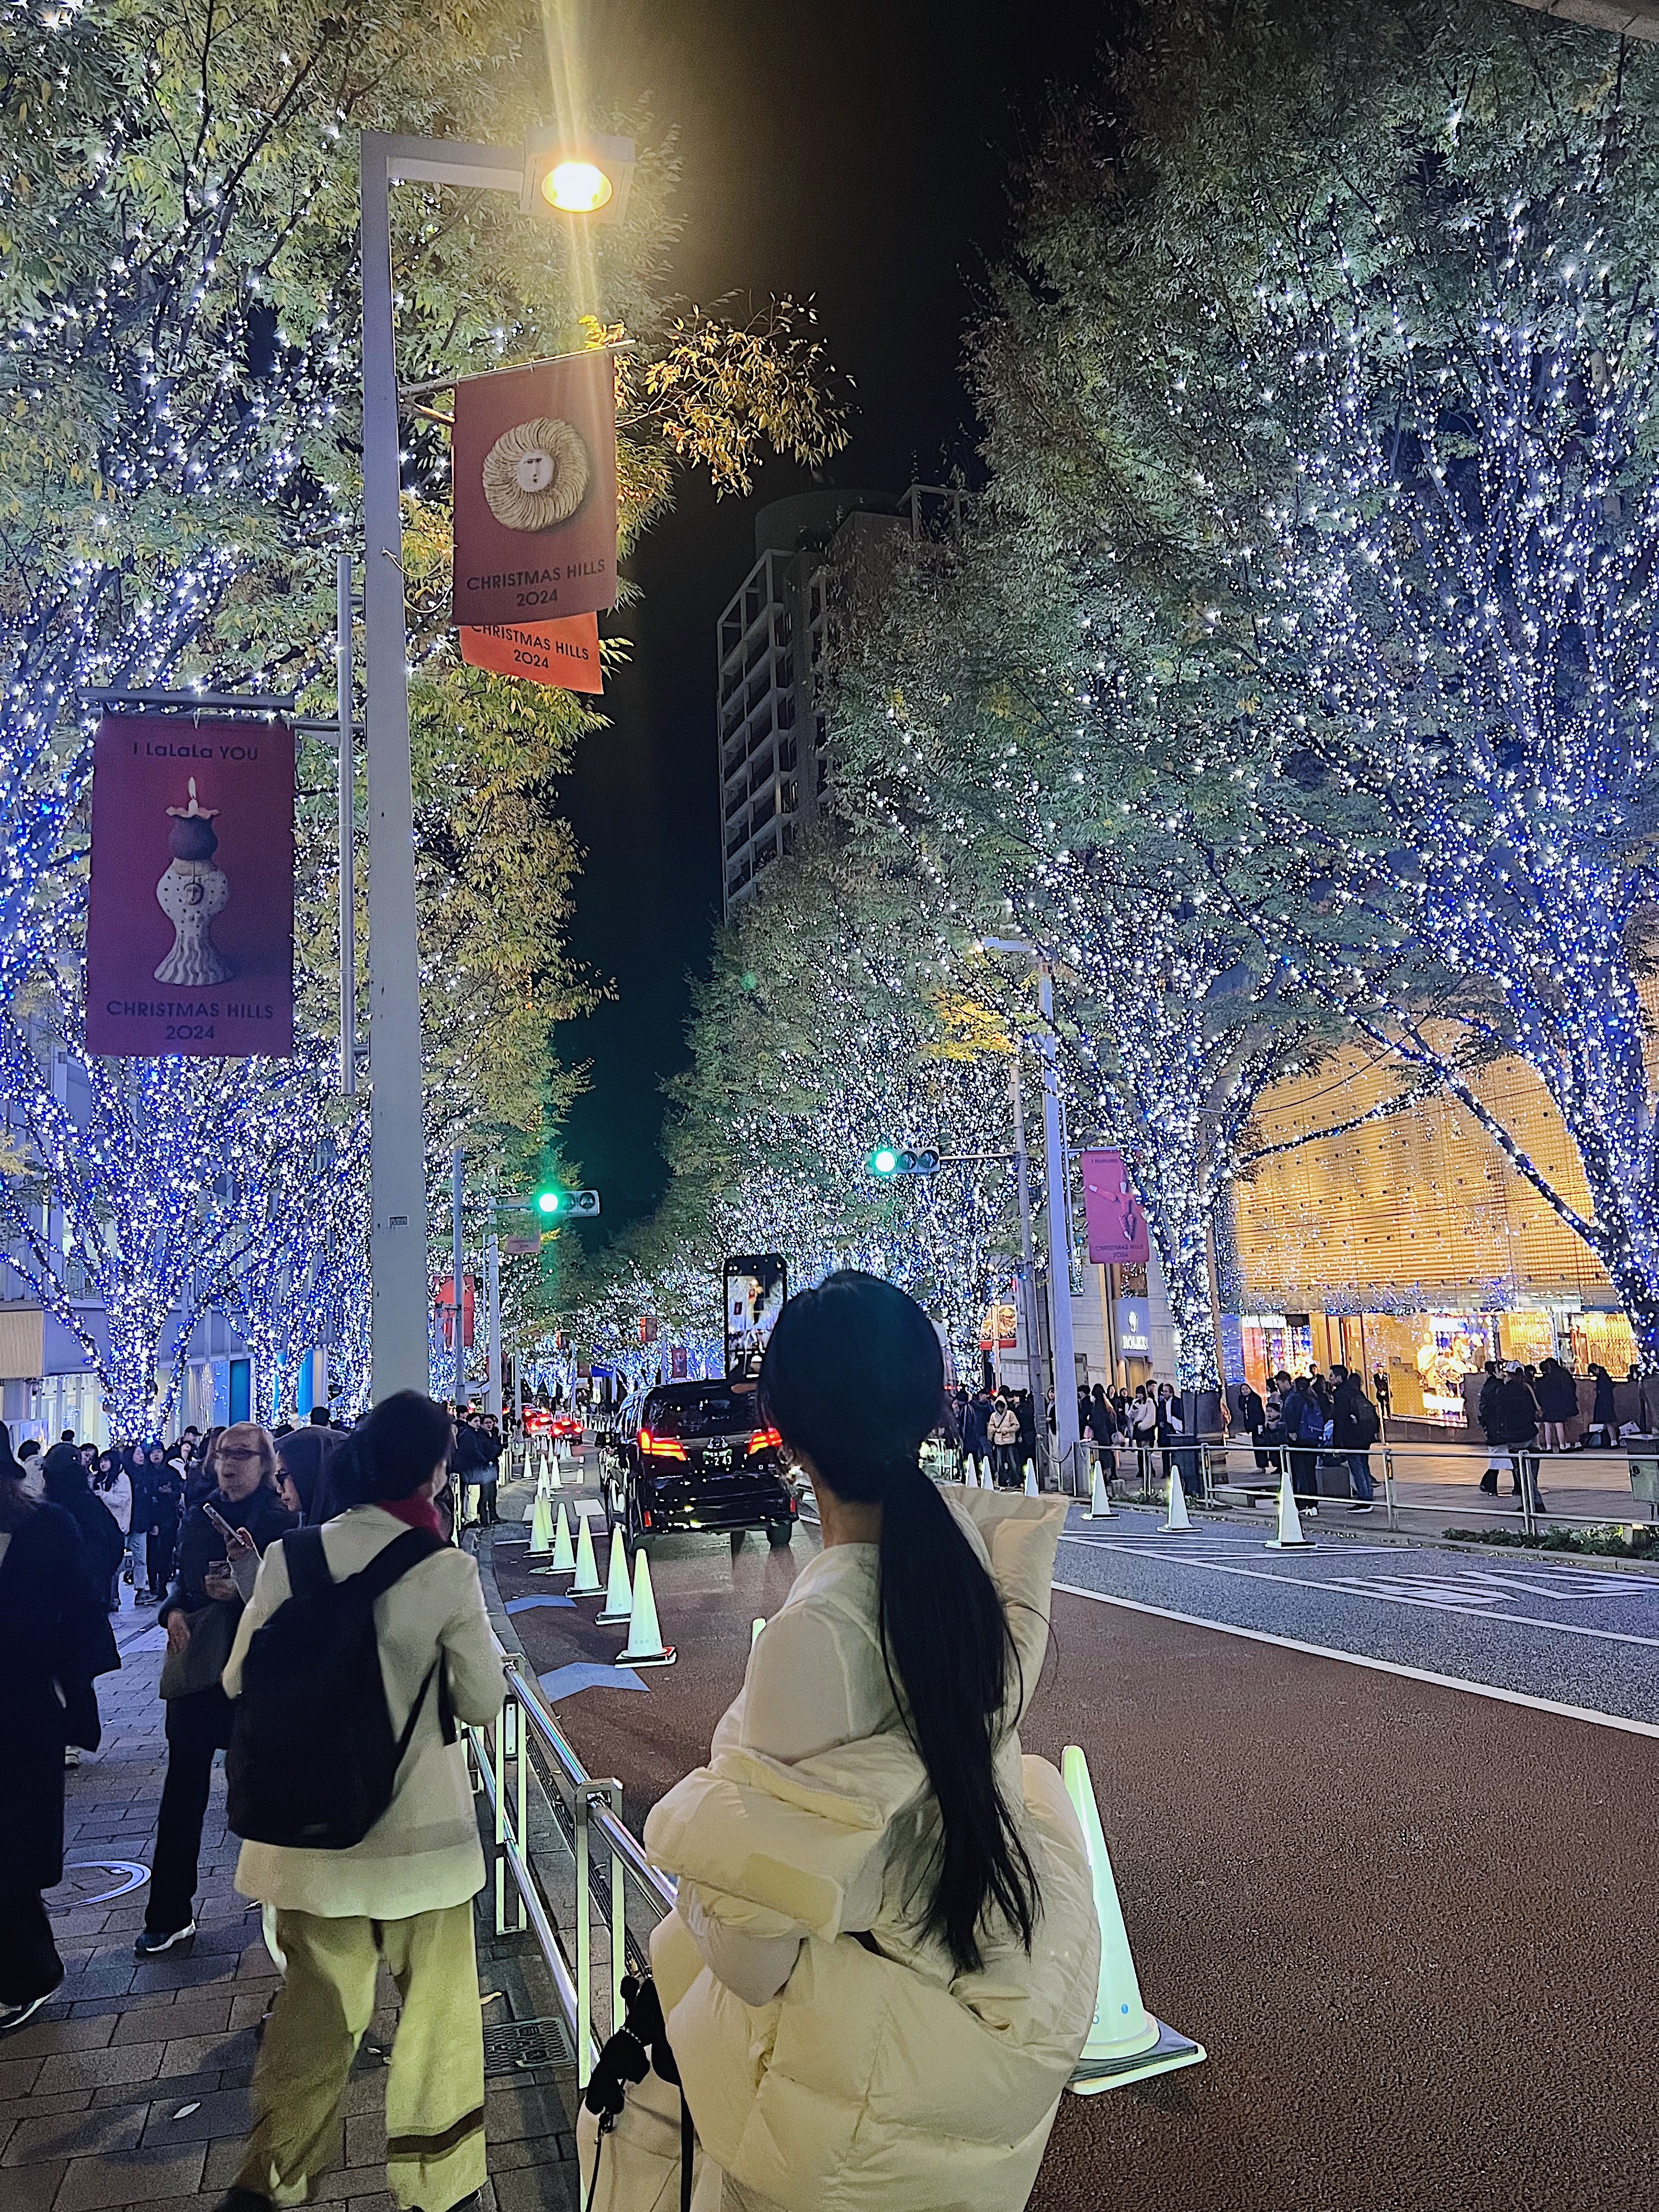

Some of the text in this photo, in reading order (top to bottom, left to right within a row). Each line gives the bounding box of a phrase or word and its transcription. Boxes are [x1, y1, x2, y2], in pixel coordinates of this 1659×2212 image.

[466, 559, 605, 590] CHRISTMAS HILLS
[517, 589, 558, 606] 2024
[513, 649, 549, 668] 2024
[556, 641, 589, 660] HILLS
[134, 742, 258, 761] I LaLaLa YOU
[107, 1000, 274, 1019] CHRISTMAS HILLS
[166, 1025, 216, 1039] 2024
